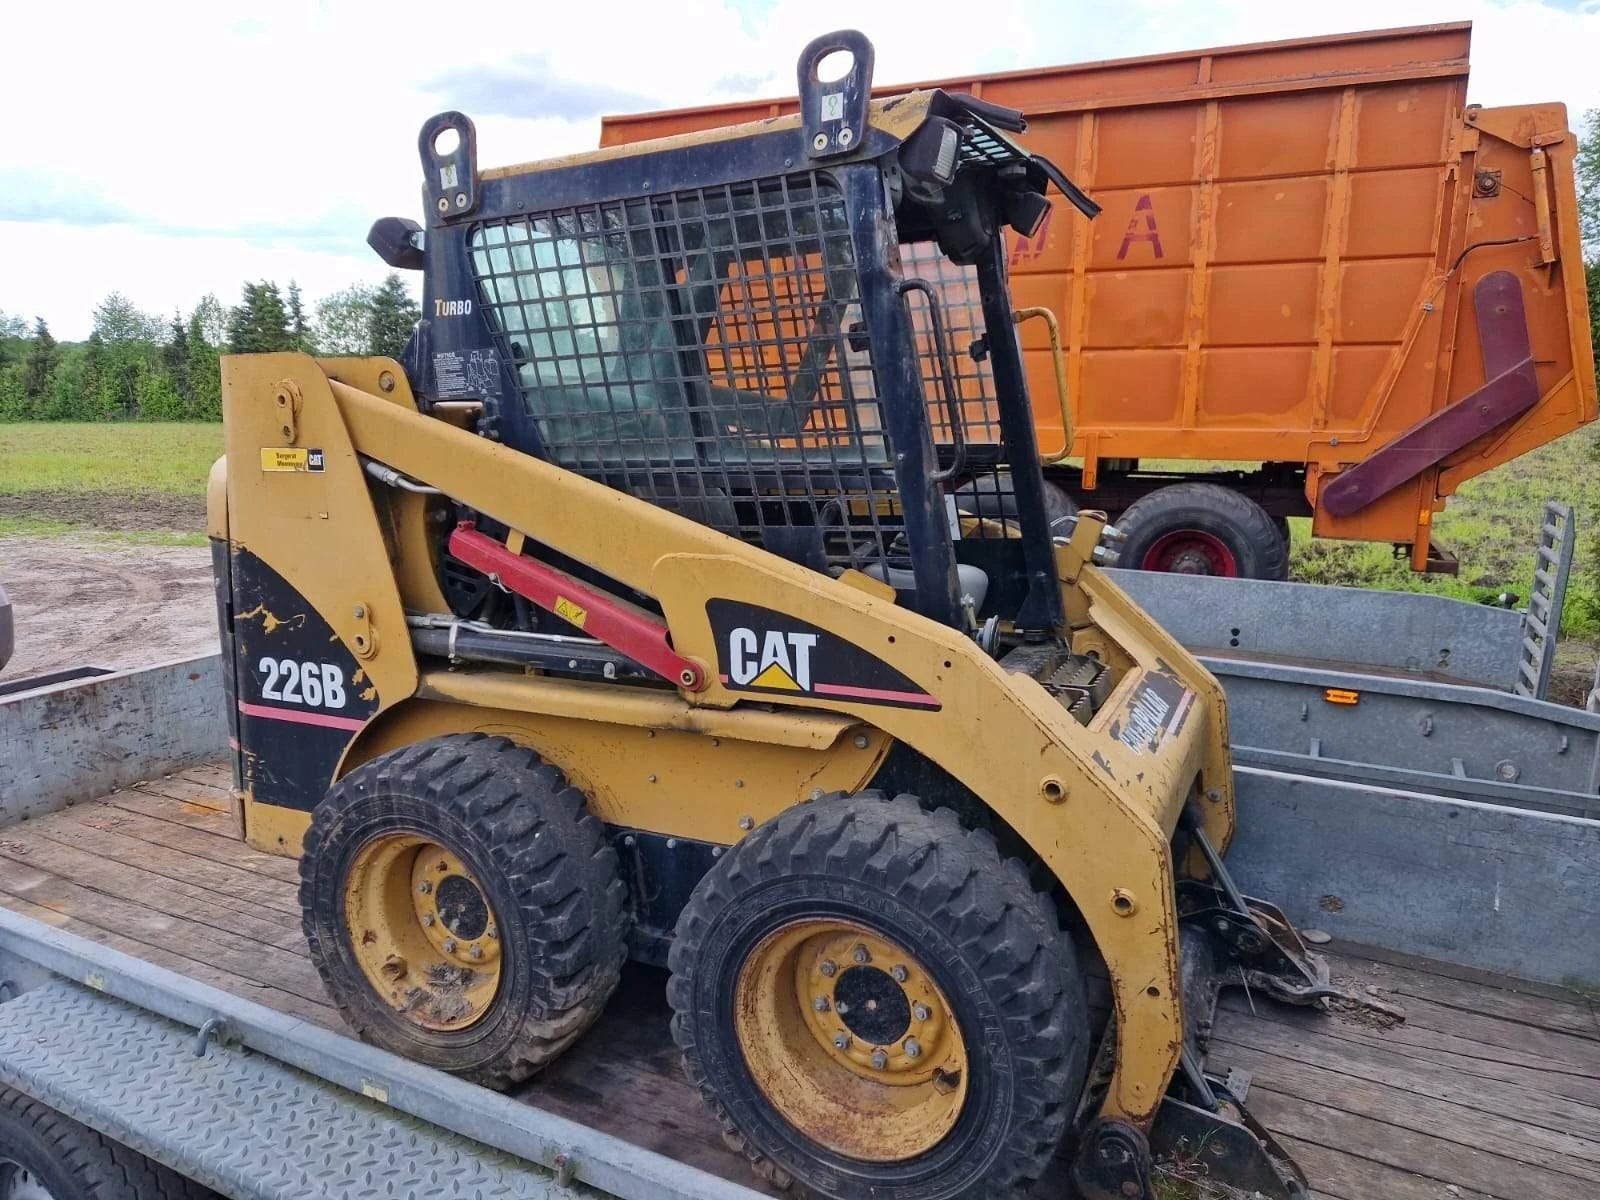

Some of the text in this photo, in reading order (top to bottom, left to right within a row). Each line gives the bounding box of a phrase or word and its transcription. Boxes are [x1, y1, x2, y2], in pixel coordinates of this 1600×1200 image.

[434, 299, 472, 316] TURBO
[309, 454, 322, 466] CAT
[730, 627, 817, 691] CAT
[259, 657, 346, 709] 226B
